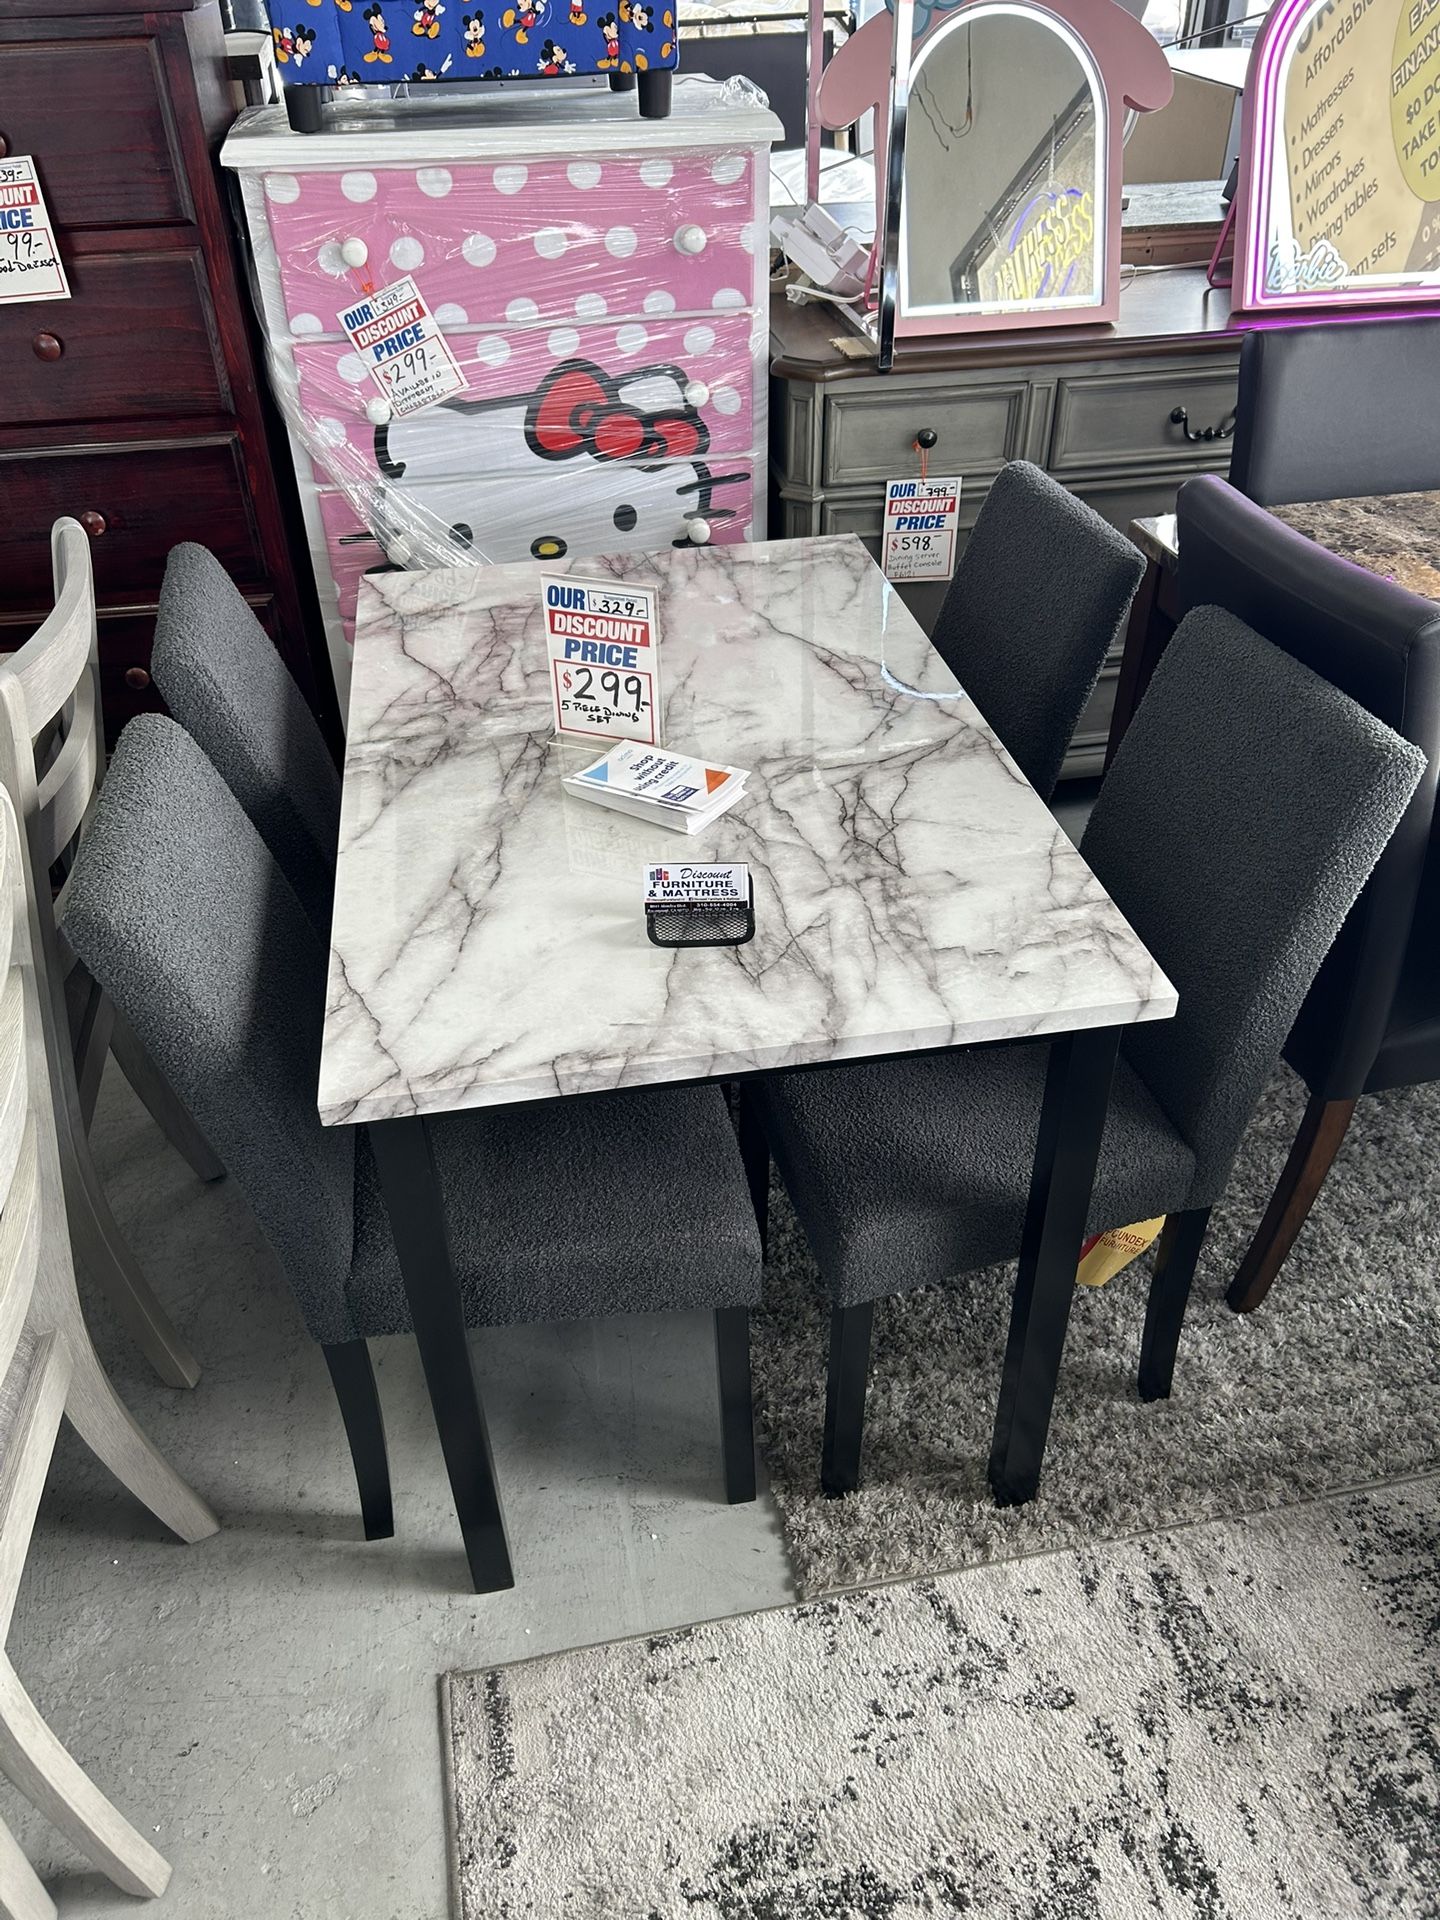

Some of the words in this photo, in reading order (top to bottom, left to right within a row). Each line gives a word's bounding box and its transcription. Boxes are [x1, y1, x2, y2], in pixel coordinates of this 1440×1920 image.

[1301, 67, 1355, 141] Mattresses
[1302, 114, 1344, 169] Dressers
[1402, 117, 1436, 160] TAKE
[1305, 152, 1342, 199] Mirrors
[1306, 157, 1366, 226] Wardrobes
[1344, 178, 1379, 222] tables
[1371, 231, 1397, 264] sets
[344, 304, 374, 331] OUR
[357, 301, 422, 347] DISCOUNT
[372, 322, 426, 363] PRICE
[889, 483, 917, 498] OUR
[890, 498, 954, 515] DISCOUNT
[895, 514, 947, 531] PRICE
[547, 585, 585, 611] OUR
[554, 613, 645, 644] DISCOUNT
[564, 638, 639, 669] PRICE
[561, 700, 572, 711] 5
[587, 714, 612, 724] SET
[629, 754, 654, 771] Shop
[634, 757, 667, 780] without
[655, 760, 679, 780] credit
[652, 880, 734, 889] FURNITURE
[680, 867, 733, 879] Discount
[648, 889, 658, 898] &
[663, 889, 739, 897] MATTRESS
